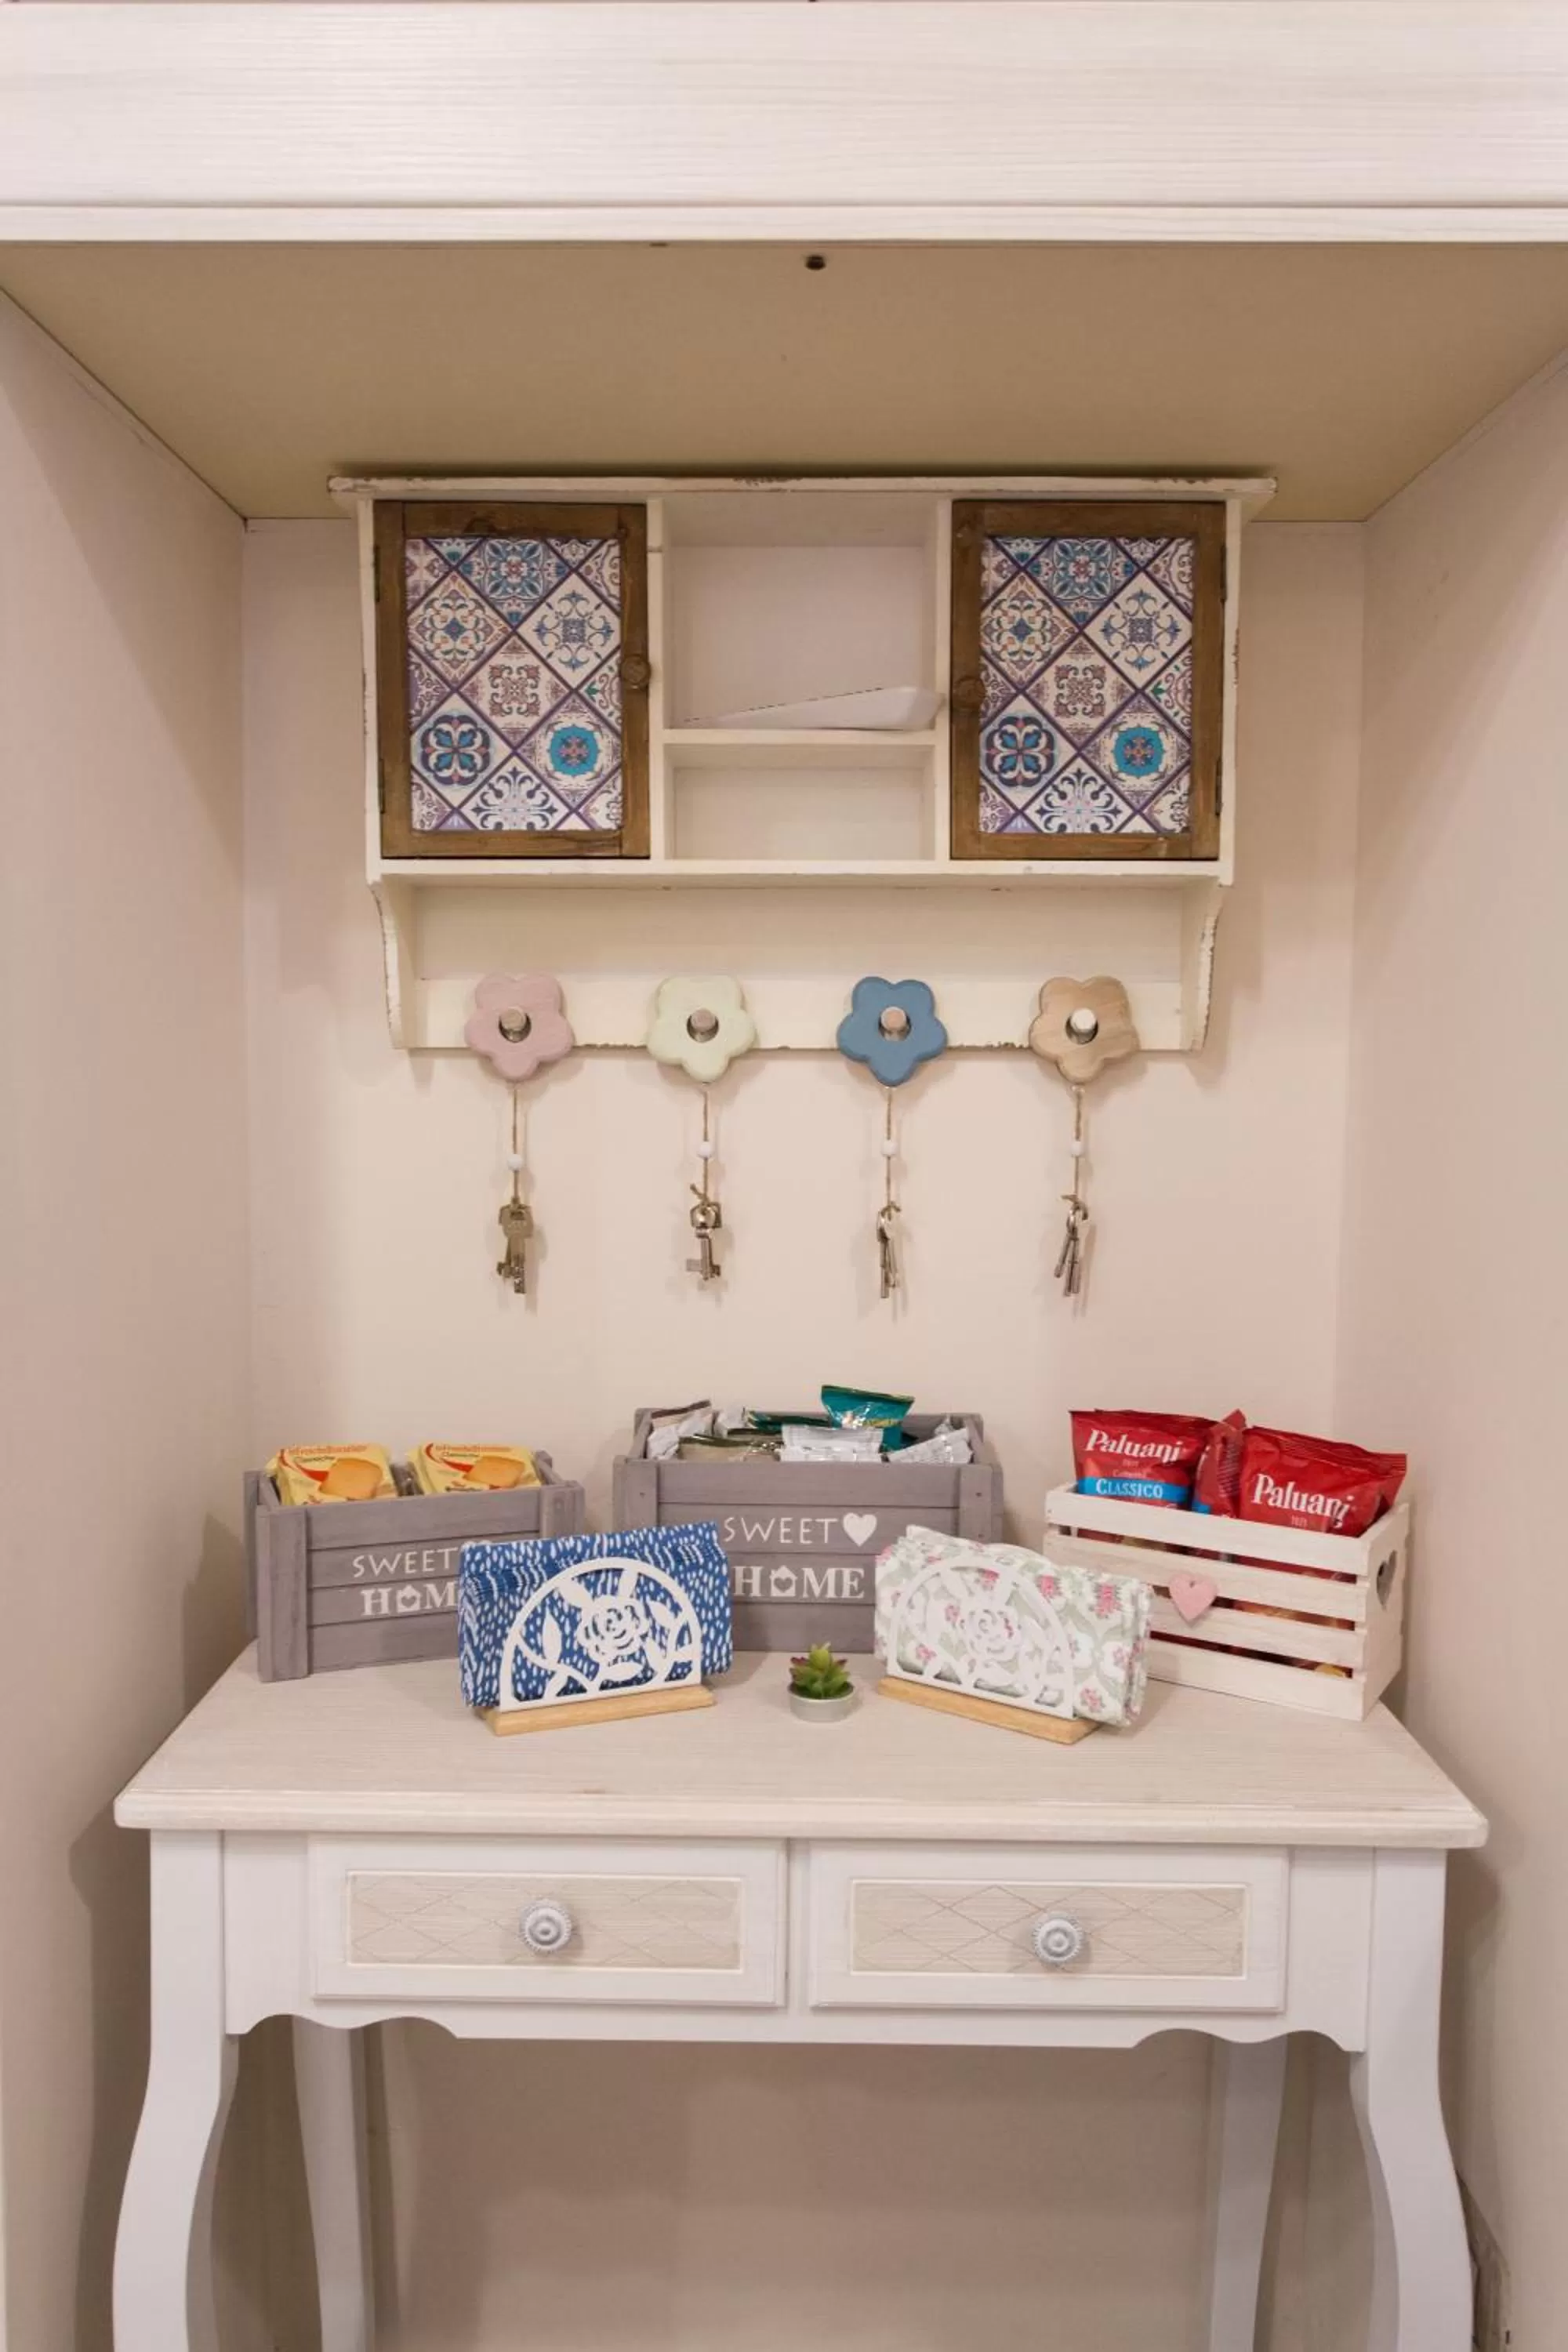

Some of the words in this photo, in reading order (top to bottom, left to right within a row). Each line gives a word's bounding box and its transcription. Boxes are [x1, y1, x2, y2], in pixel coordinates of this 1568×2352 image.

[1086, 1428, 1183, 1464] Paluani
[1251, 1473, 1355, 1528] Paluani
[724, 1515, 838, 1544] SWEET
[352, 1547, 459, 1577] SWEET
[361, 1581, 458, 1616] HOM
[733, 1565, 865, 1599] HOME
